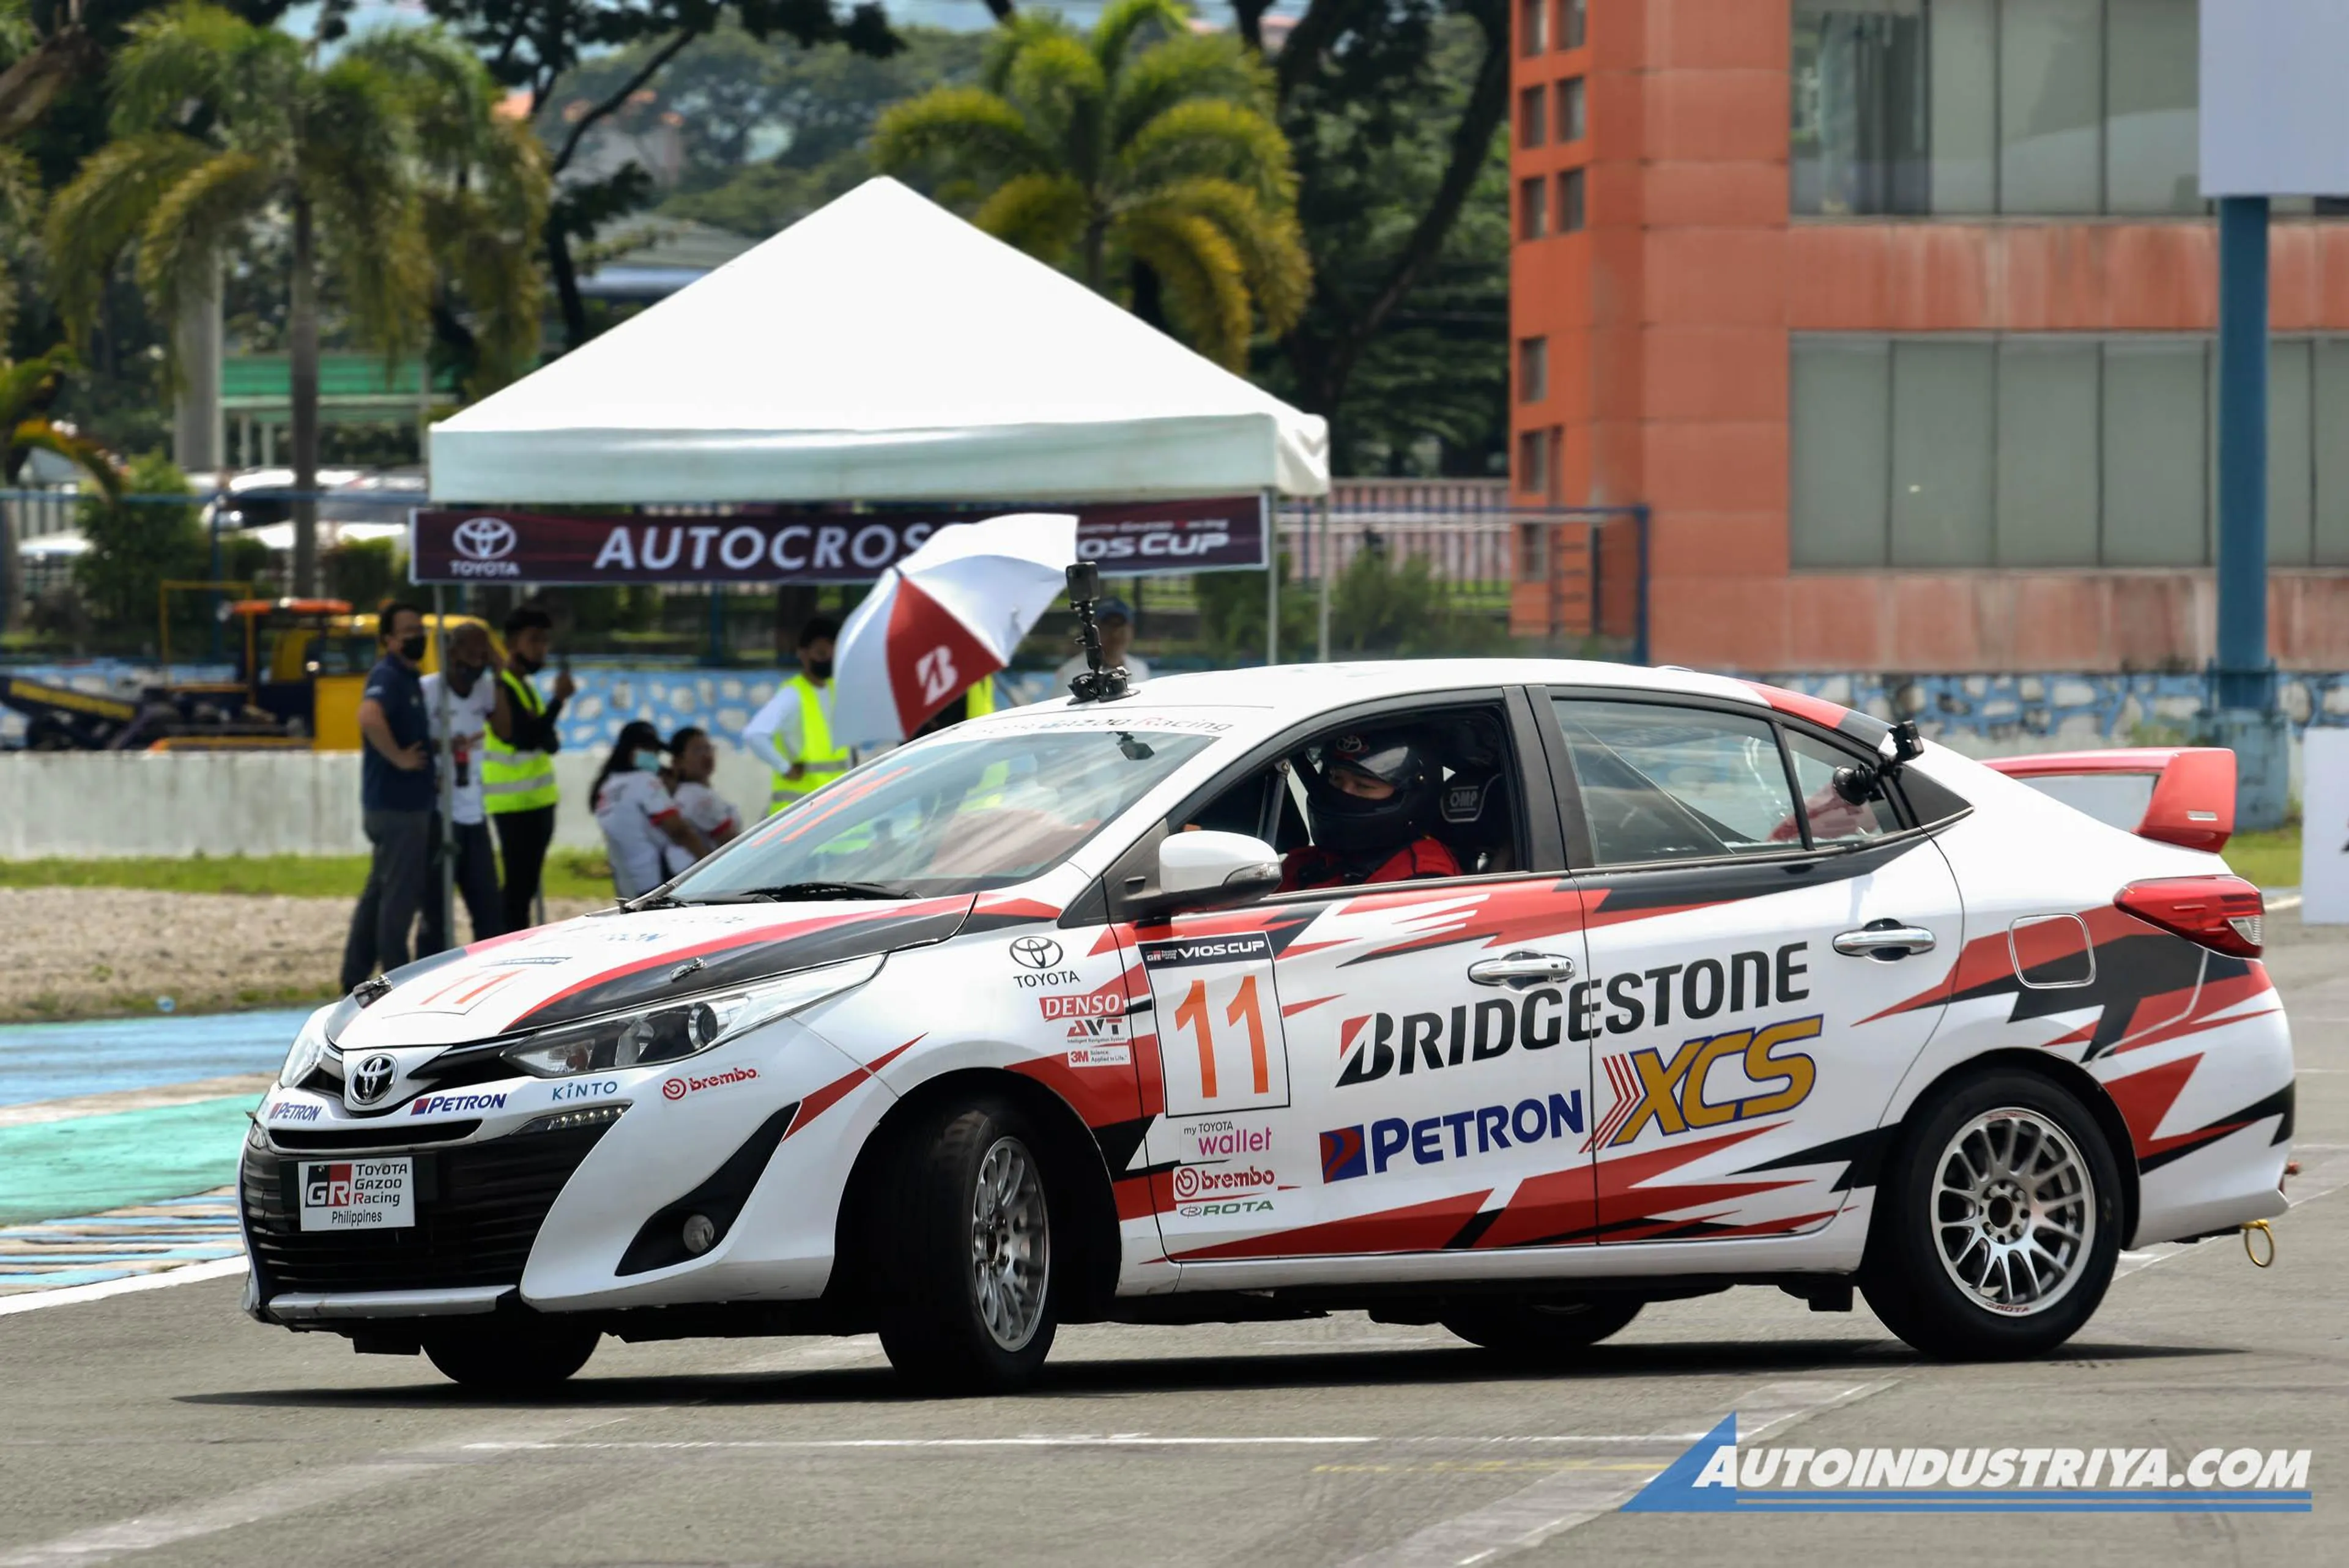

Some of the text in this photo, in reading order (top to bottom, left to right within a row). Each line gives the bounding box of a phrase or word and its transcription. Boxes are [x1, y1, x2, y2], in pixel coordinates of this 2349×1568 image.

[1140, 533, 1229, 555] CUP
[450, 560, 520, 577] TOYOTA
[1450, 790, 1478, 807] OMP
[1178, 944, 1226, 958] VIOS
[1228, 941, 1265, 953] CUP
[1014, 970, 1080, 988] TOYOTA
[1045, 994, 1119, 1017] DENSO
[1335, 941, 1809, 1087] BRIDGESTONE
[1067, 1018, 1123, 1037] AVT
[1174, 975, 1269, 1098] 11
[1071, 1051, 1089, 1063] 3M
[1607, 1013, 1824, 1148] XCS
[276, 1103, 323, 1122] PETRON
[428, 1093, 508, 1114] PETRON
[1184, 1121, 1234, 1136] my TOYOTA
[1371, 1089, 1584, 1175] PETRON
[1198, 1126, 1272, 1156] wallet
[355, 1164, 407, 1175] TOYOTA
[1202, 1166, 1275, 1189] brembo
[307, 1181, 349, 1205] GR
[355, 1178, 402, 1190] GAZOO
[354, 1192, 400, 1207] Racing
[1203, 1200, 1274, 1216] ROTA
[332, 1209, 382, 1226] Philippines
